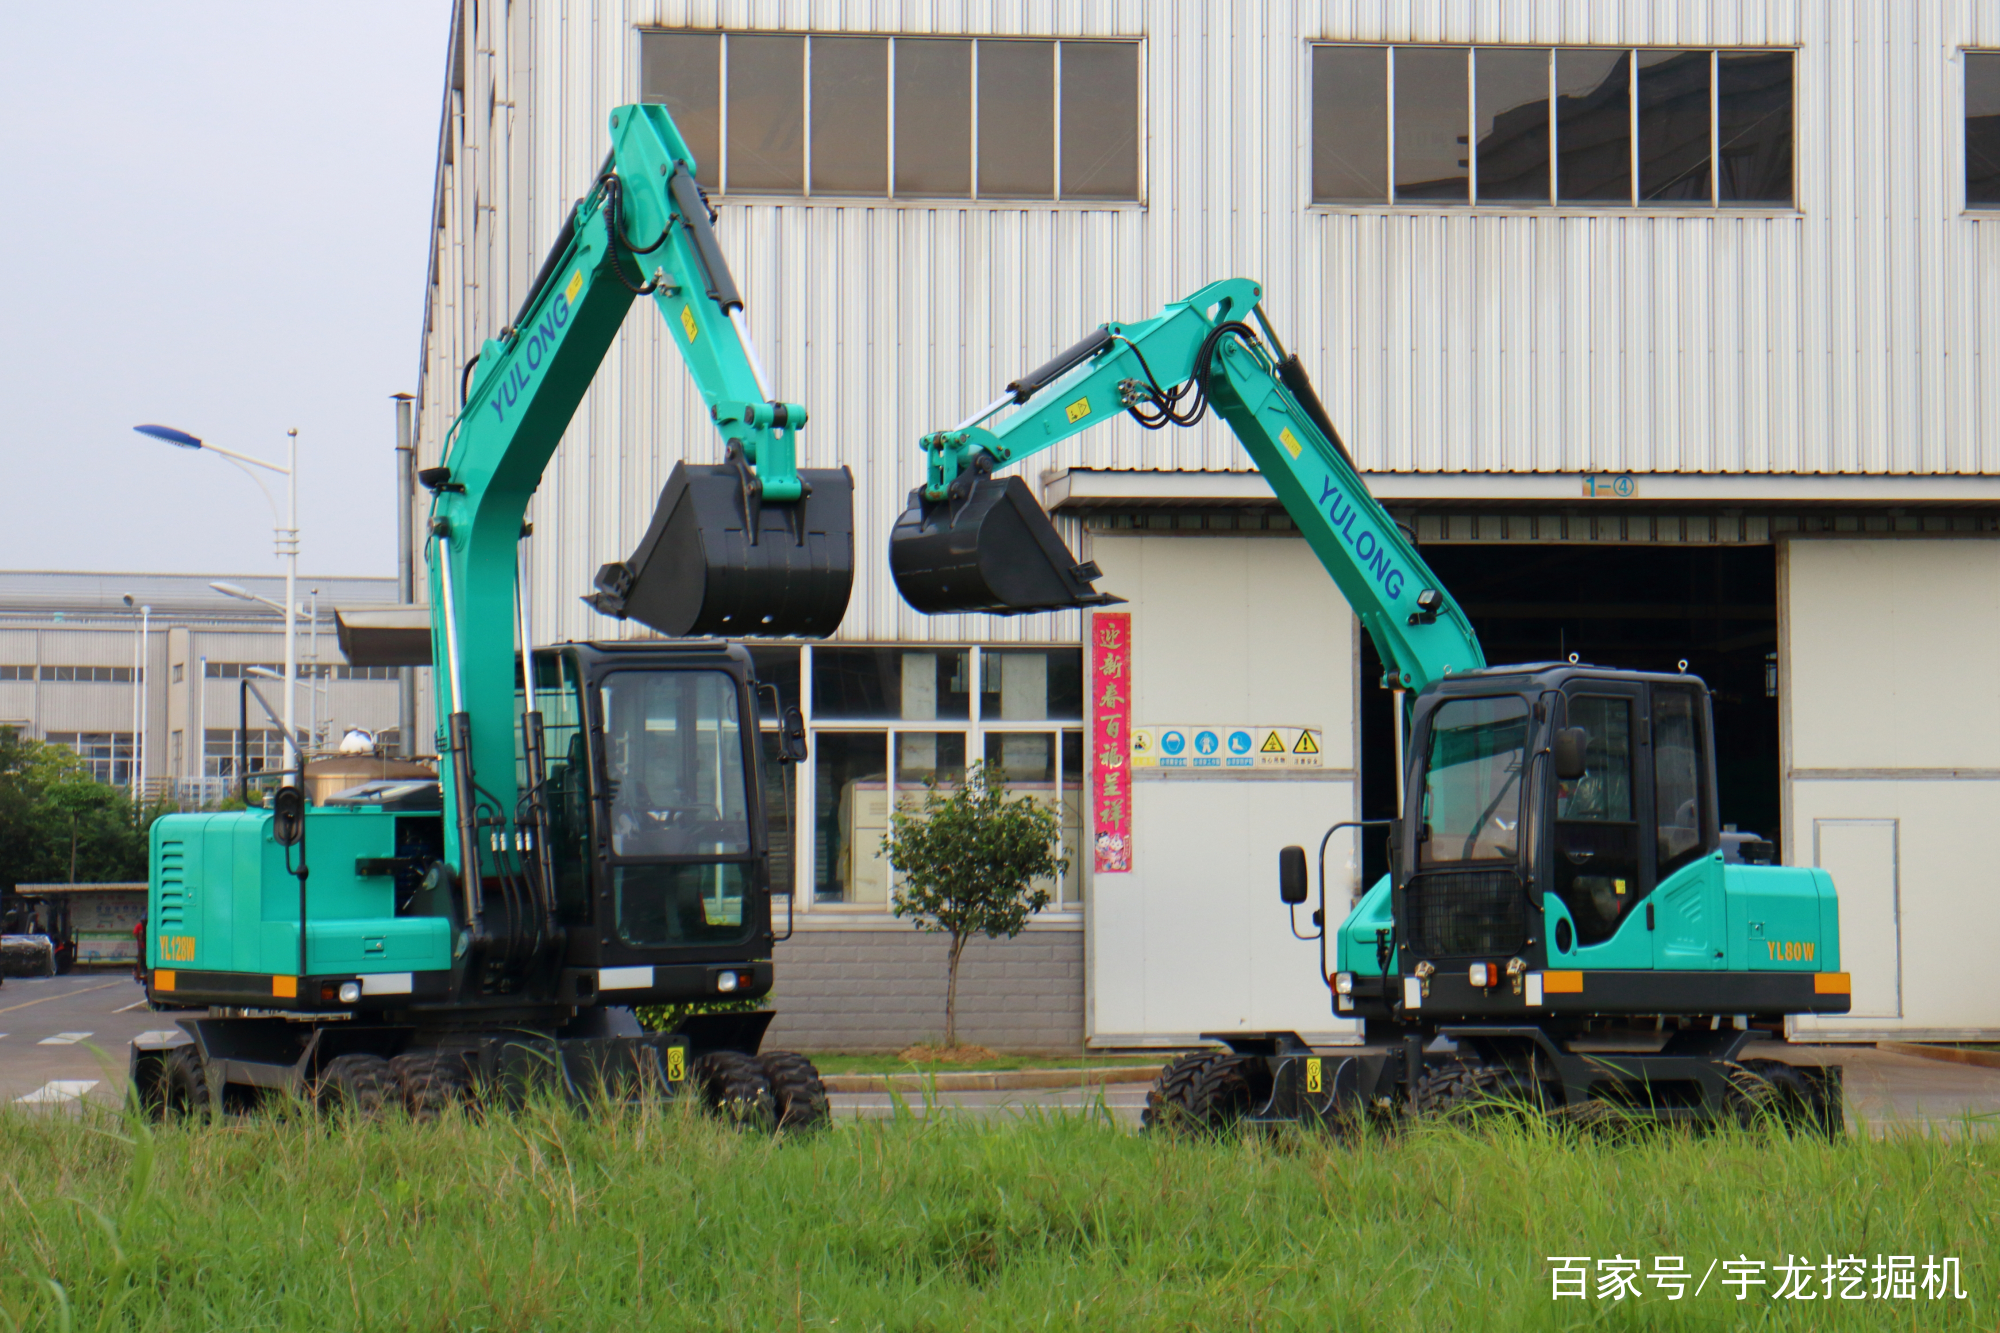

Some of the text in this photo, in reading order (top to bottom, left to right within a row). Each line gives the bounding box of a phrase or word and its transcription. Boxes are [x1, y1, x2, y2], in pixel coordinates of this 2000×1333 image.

[490, 293, 569, 423] YULONG
[1319, 474, 1405, 600] YULONG
[1099, 623, 1125, 830] 迎新春百福呈祥
[1767, 940, 1815, 962] YL80W
